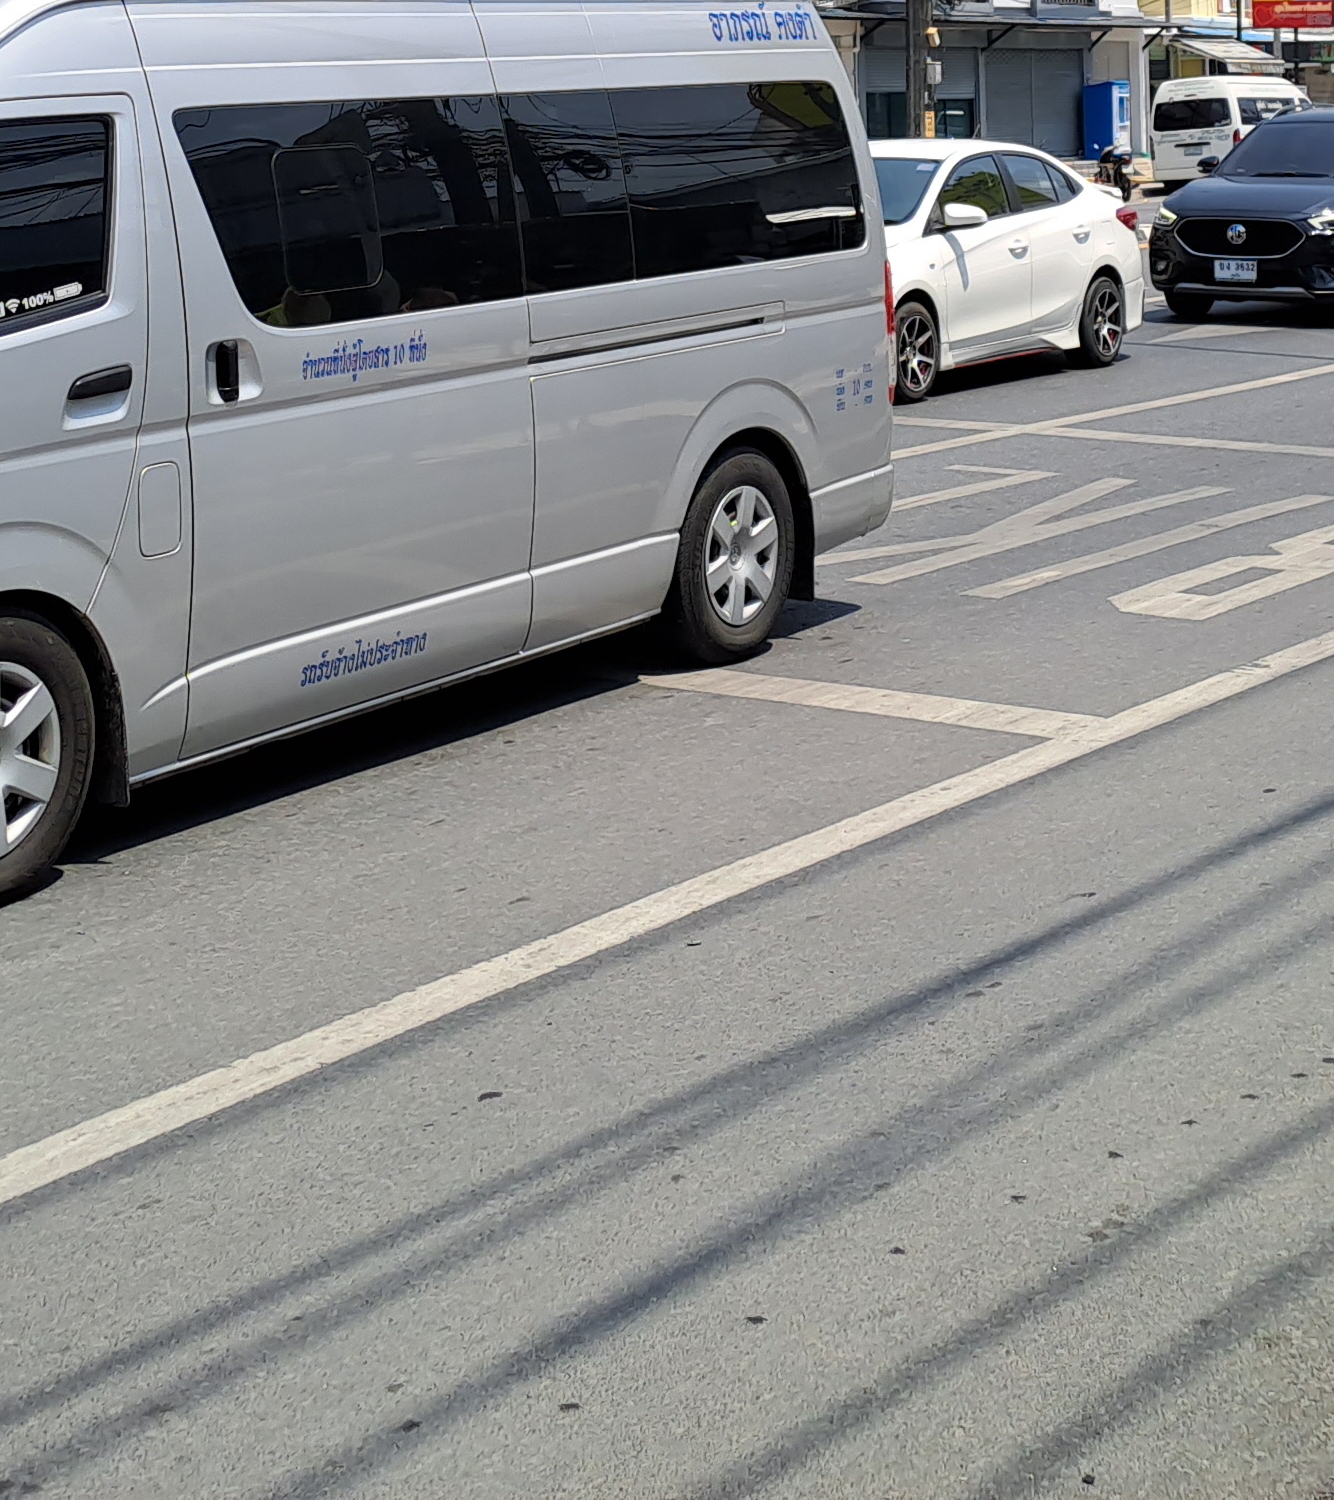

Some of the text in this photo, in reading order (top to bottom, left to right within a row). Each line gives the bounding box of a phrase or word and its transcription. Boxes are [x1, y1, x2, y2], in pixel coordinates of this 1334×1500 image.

[708, 1, 772, 42] อาภรณ์
[21, 291, 55, 310] 100%
[393, 343, 405, 365] 10
